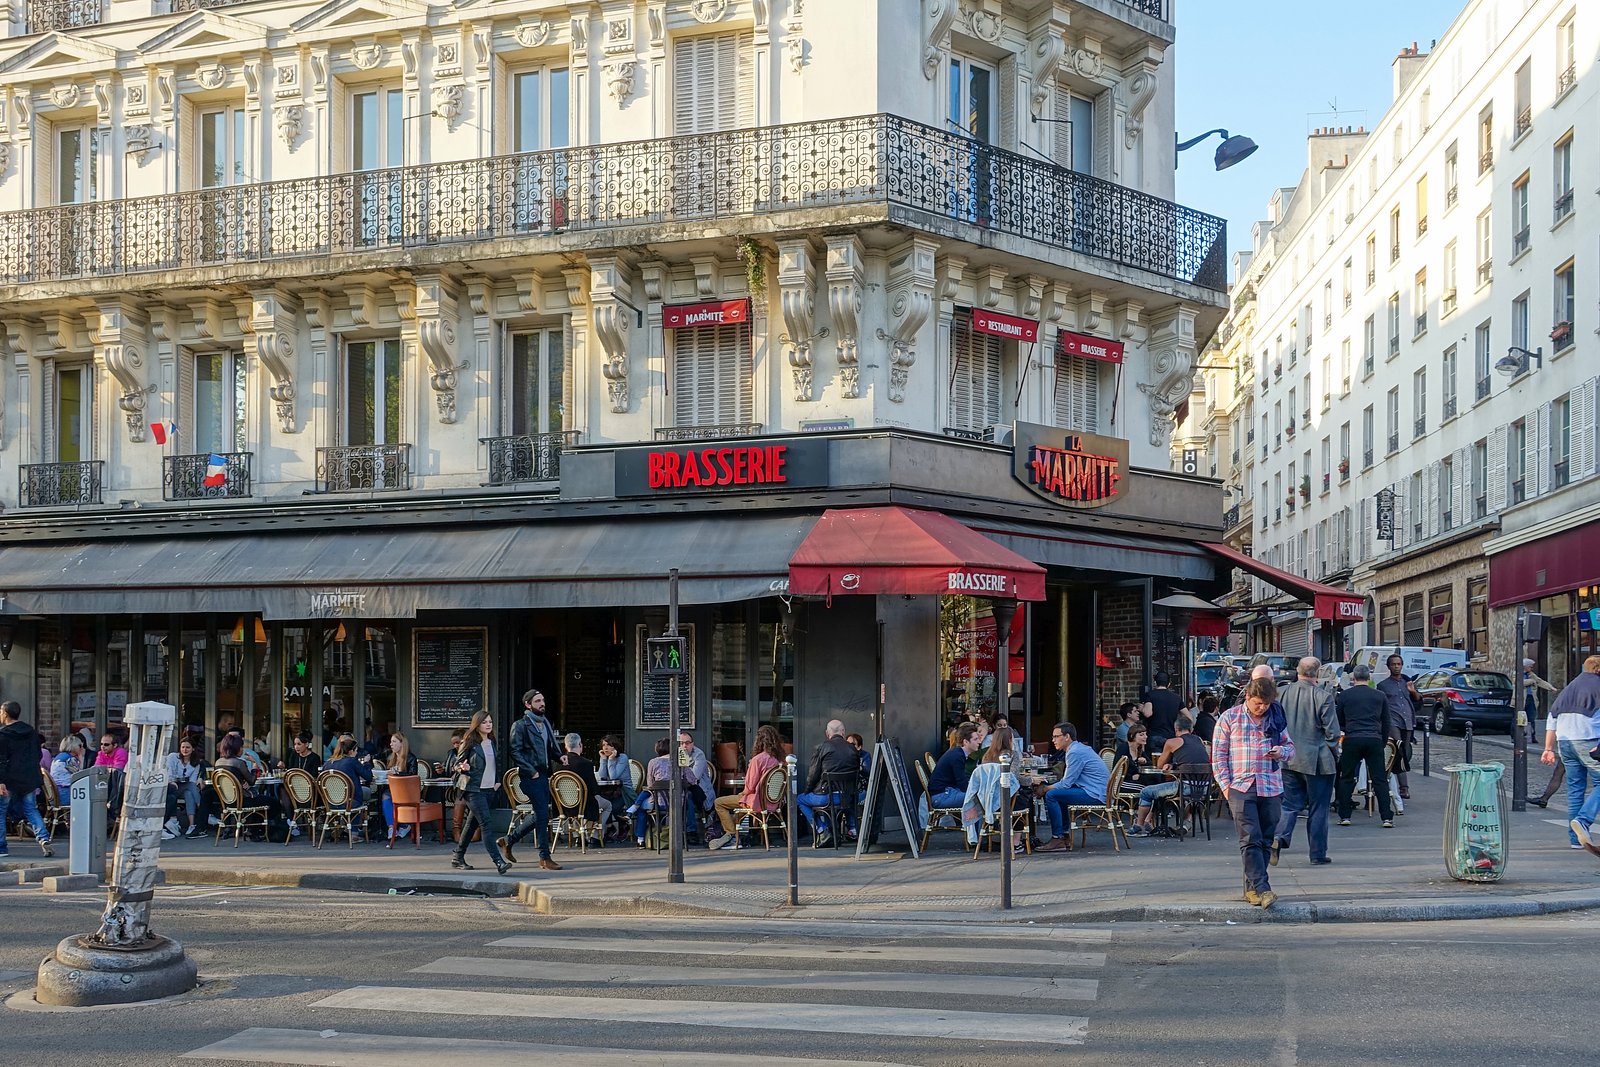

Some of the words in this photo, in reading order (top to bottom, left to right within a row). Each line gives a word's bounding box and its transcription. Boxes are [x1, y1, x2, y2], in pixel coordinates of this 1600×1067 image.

[685, 311, 724, 325] MARMITE
[988, 320, 1022, 336] RESTAURANT
[1081, 343, 1107, 357] BRASSERIE
[1072, 435, 1083, 451] LA
[648, 445, 787, 488] BRASSERIE
[1032, 449, 1121, 500] MARMITE
[948, 572, 1006, 591] BRASSERIE
[311, 594, 366, 612] MARMITE
[72, 787, 86, 800] 05
